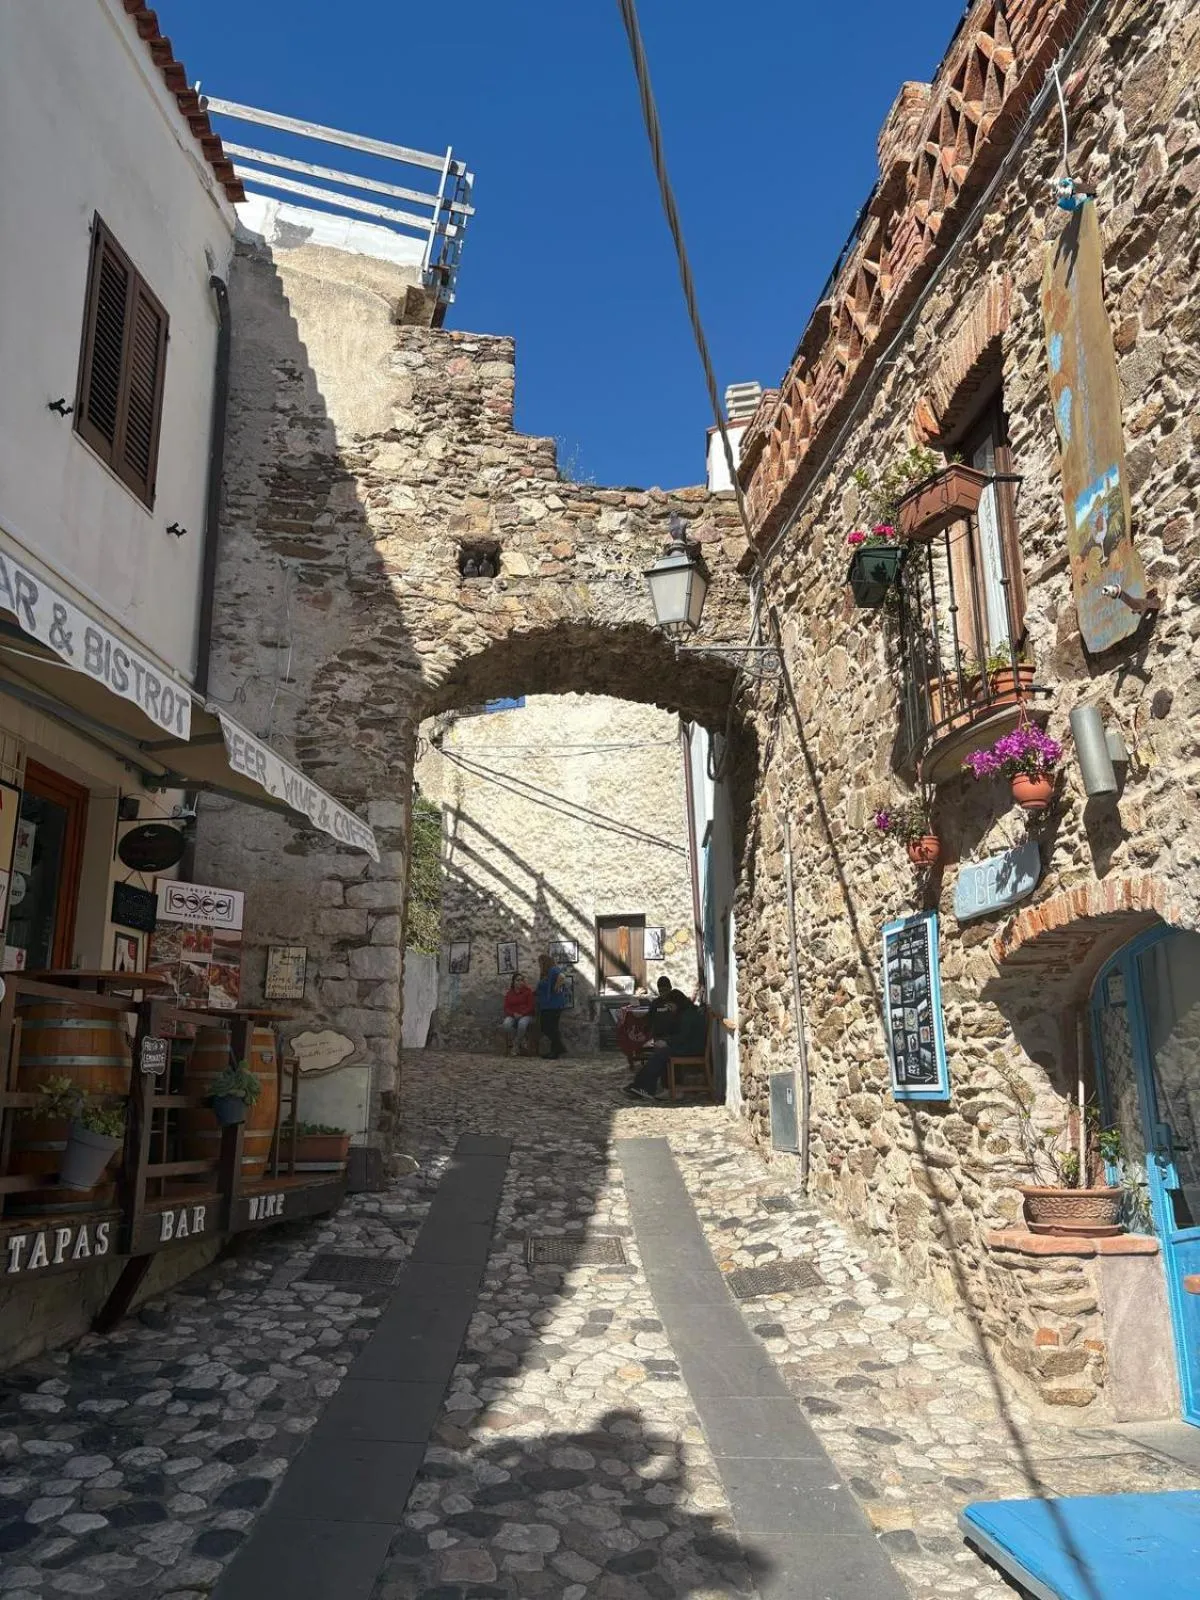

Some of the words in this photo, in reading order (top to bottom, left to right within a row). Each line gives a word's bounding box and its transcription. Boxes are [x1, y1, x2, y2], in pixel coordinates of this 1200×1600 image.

[49, 603, 73, 656] &
[83, 626, 189, 734] BISTROT
[318, 798, 332, 829] &
[6, 1222, 110, 1274] TAPAS
[159, 1206, 207, 1243] BAR
[248, 1193, 286, 1221] WINE
